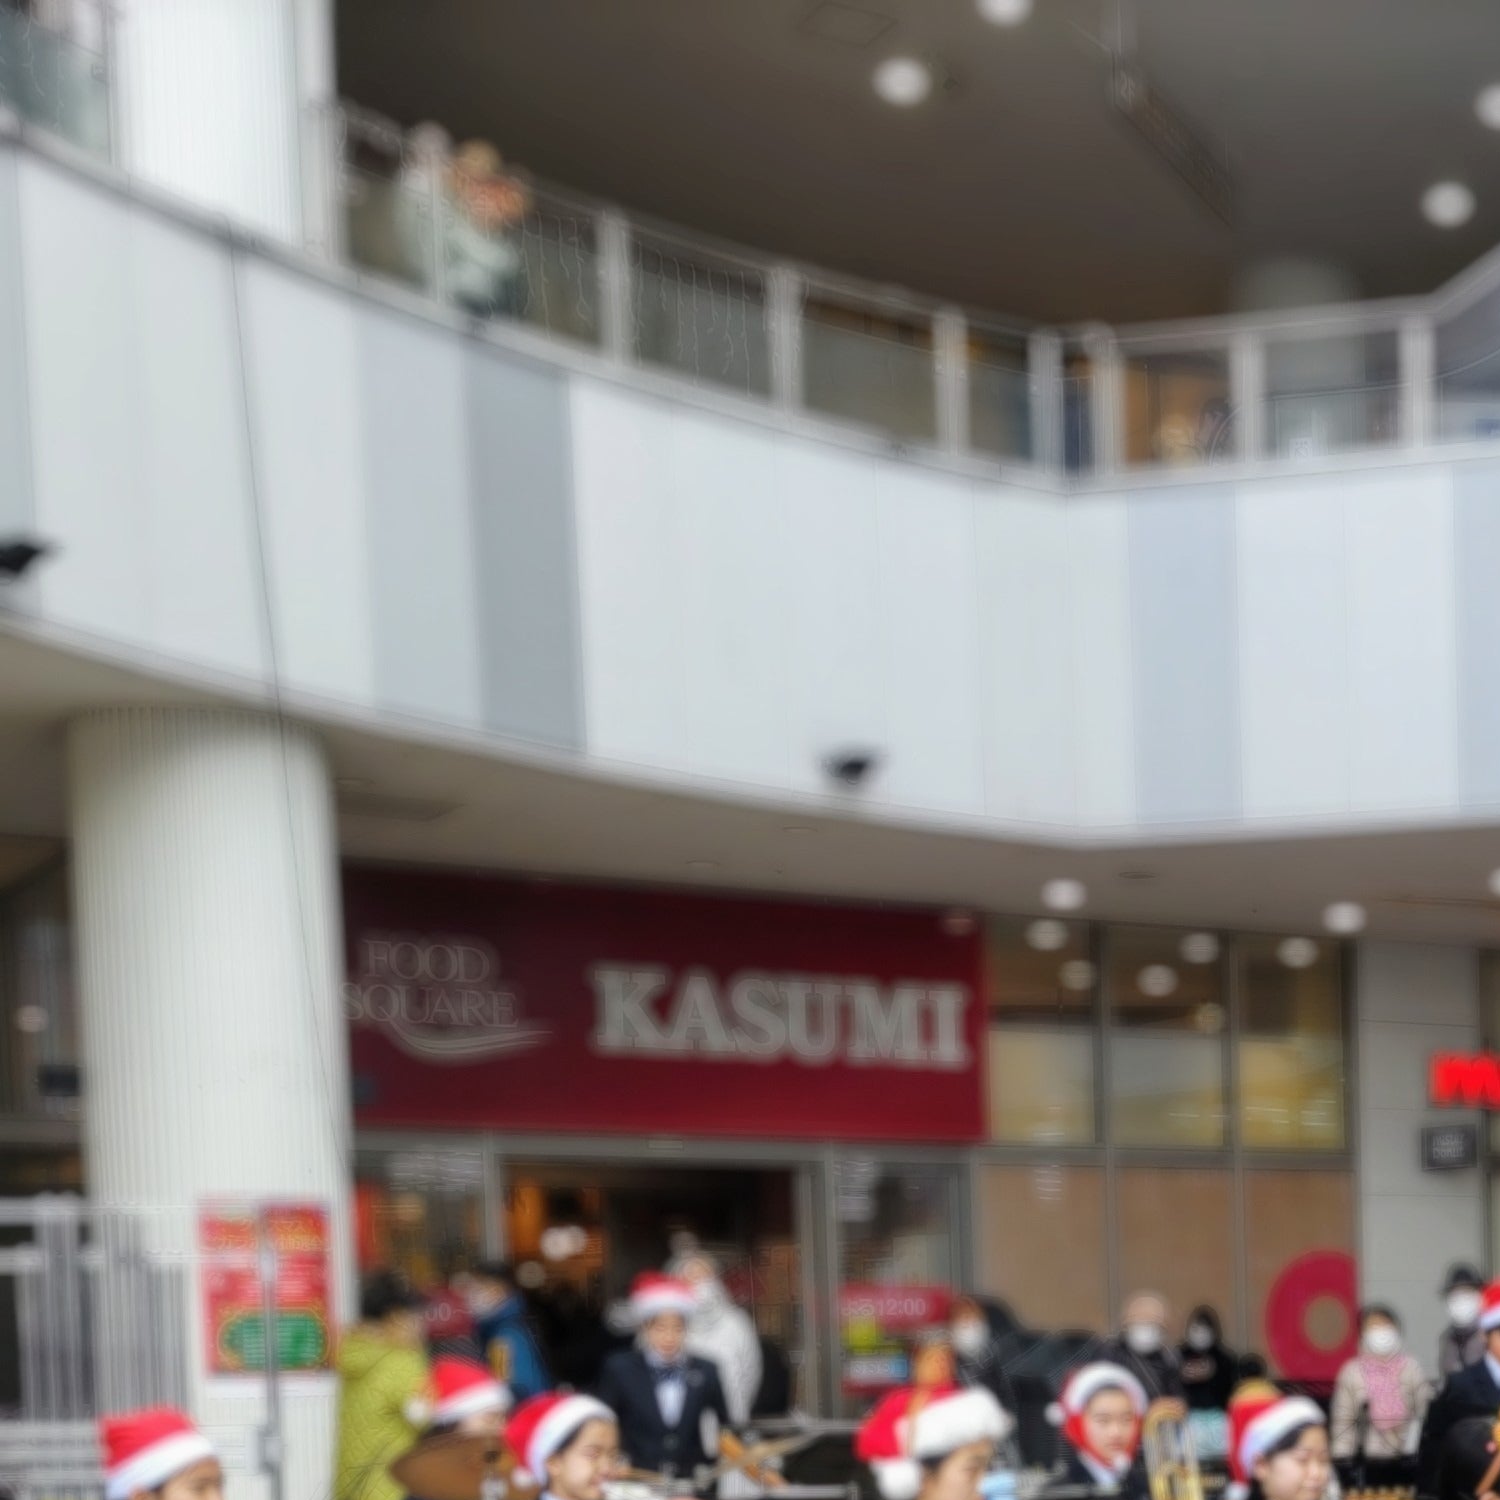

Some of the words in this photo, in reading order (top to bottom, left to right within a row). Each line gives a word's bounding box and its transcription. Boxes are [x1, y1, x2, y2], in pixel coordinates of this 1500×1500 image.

[362, 937, 491, 983] FOOD
[342, 982, 520, 1030] SQUARE
[593, 965, 970, 1068] KASUMI
